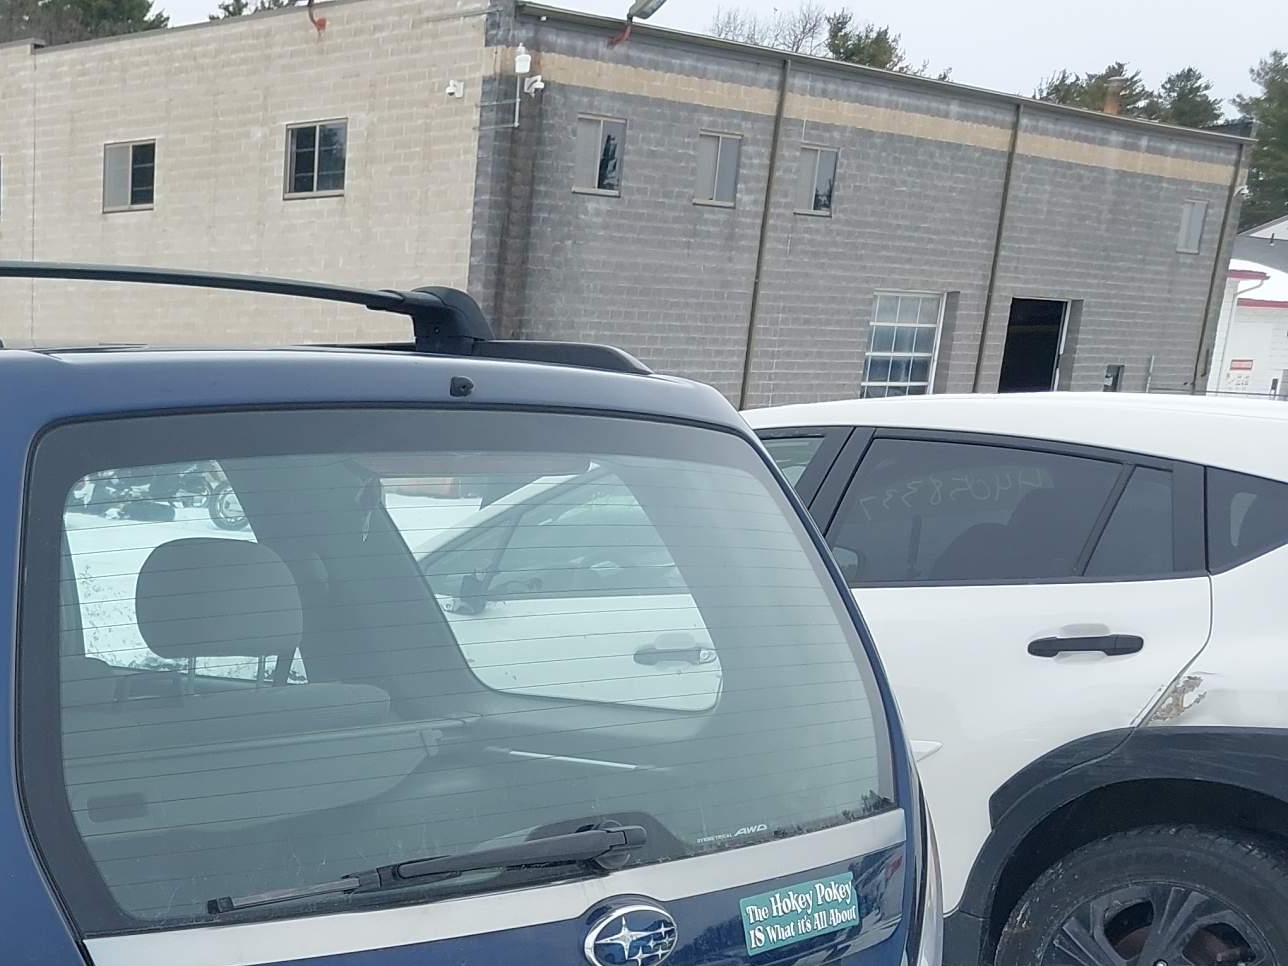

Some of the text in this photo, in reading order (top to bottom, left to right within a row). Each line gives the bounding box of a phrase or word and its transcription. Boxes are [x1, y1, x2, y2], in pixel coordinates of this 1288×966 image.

[734, 824, 768, 837] AWD
[746, 880, 853, 924] The Hokey Pokey
[749, 905, 857, 949] IS What it's All About
